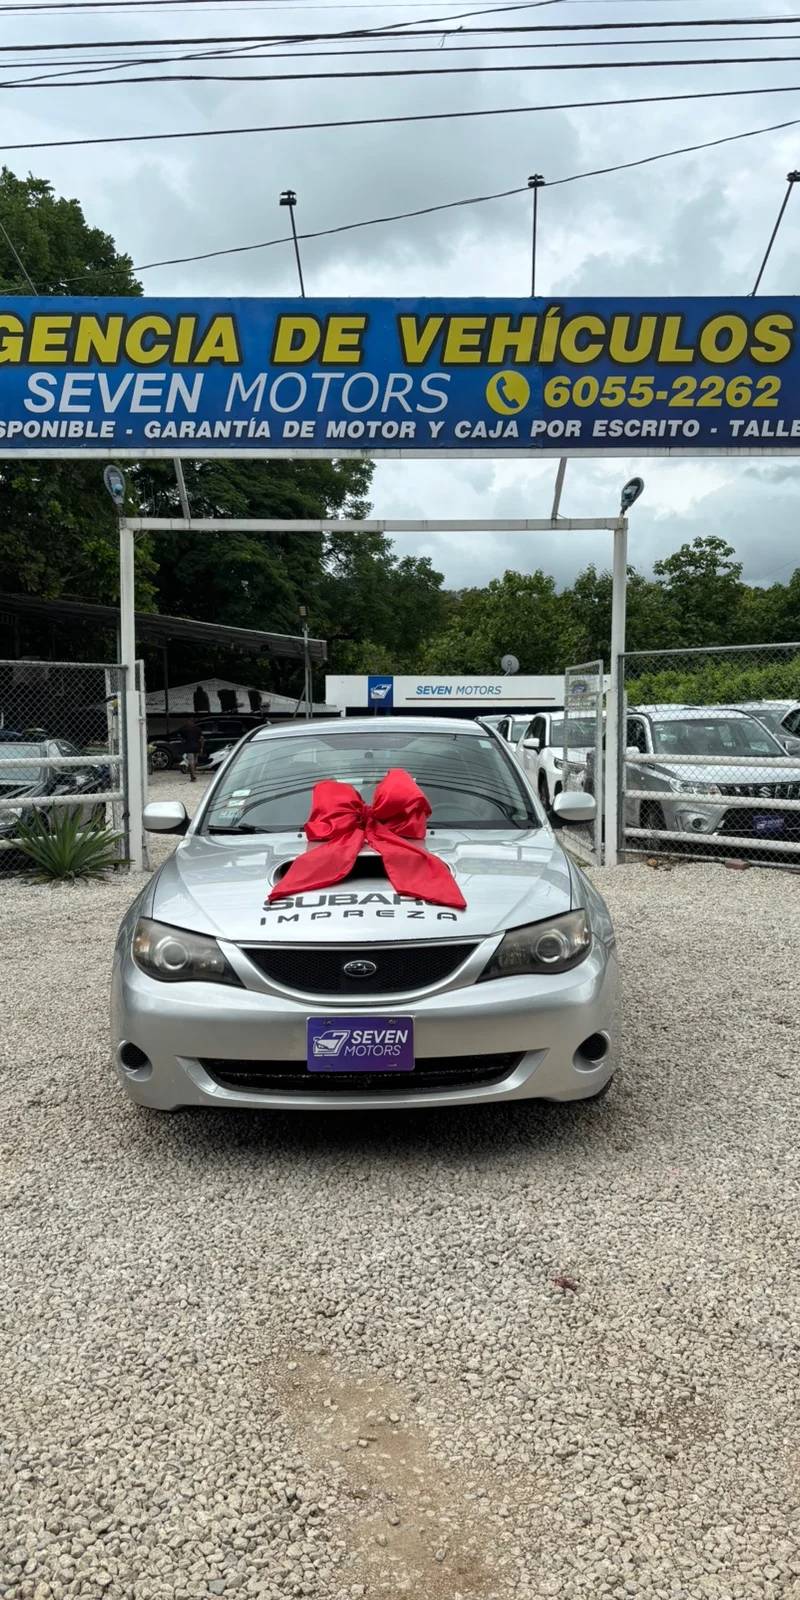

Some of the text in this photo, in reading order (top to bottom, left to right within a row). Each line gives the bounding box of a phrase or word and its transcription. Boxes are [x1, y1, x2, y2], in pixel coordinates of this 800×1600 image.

[272, 315, 367, 363] DE
[399, 306, 794, 364] VEHÍCULOS
[23, 371, 452, 414] SEVEN MOTORS
[543, 375, 782, 408] 6055-2262
[143, 416, 271, 439] GARANTÍA
[282, 420, 315, 438] DE
[325, 420, 416, 439] MOTOR
[428, 420, 446, 438] Y
[454, 419, 519, 439] CAJA
[530, 419, 582, 438] POR
[592, 419, 700, 438] ESCRITO
[416, 685, 502, 695] SEVEN MOTORS
[262, 892, 440, 912] SUBAR
[260, 909, 458, 926] IMPREZA
[351, 1030, 408, 1044] SEVEN
[344, 1045, 402, 1056] MOTORS
